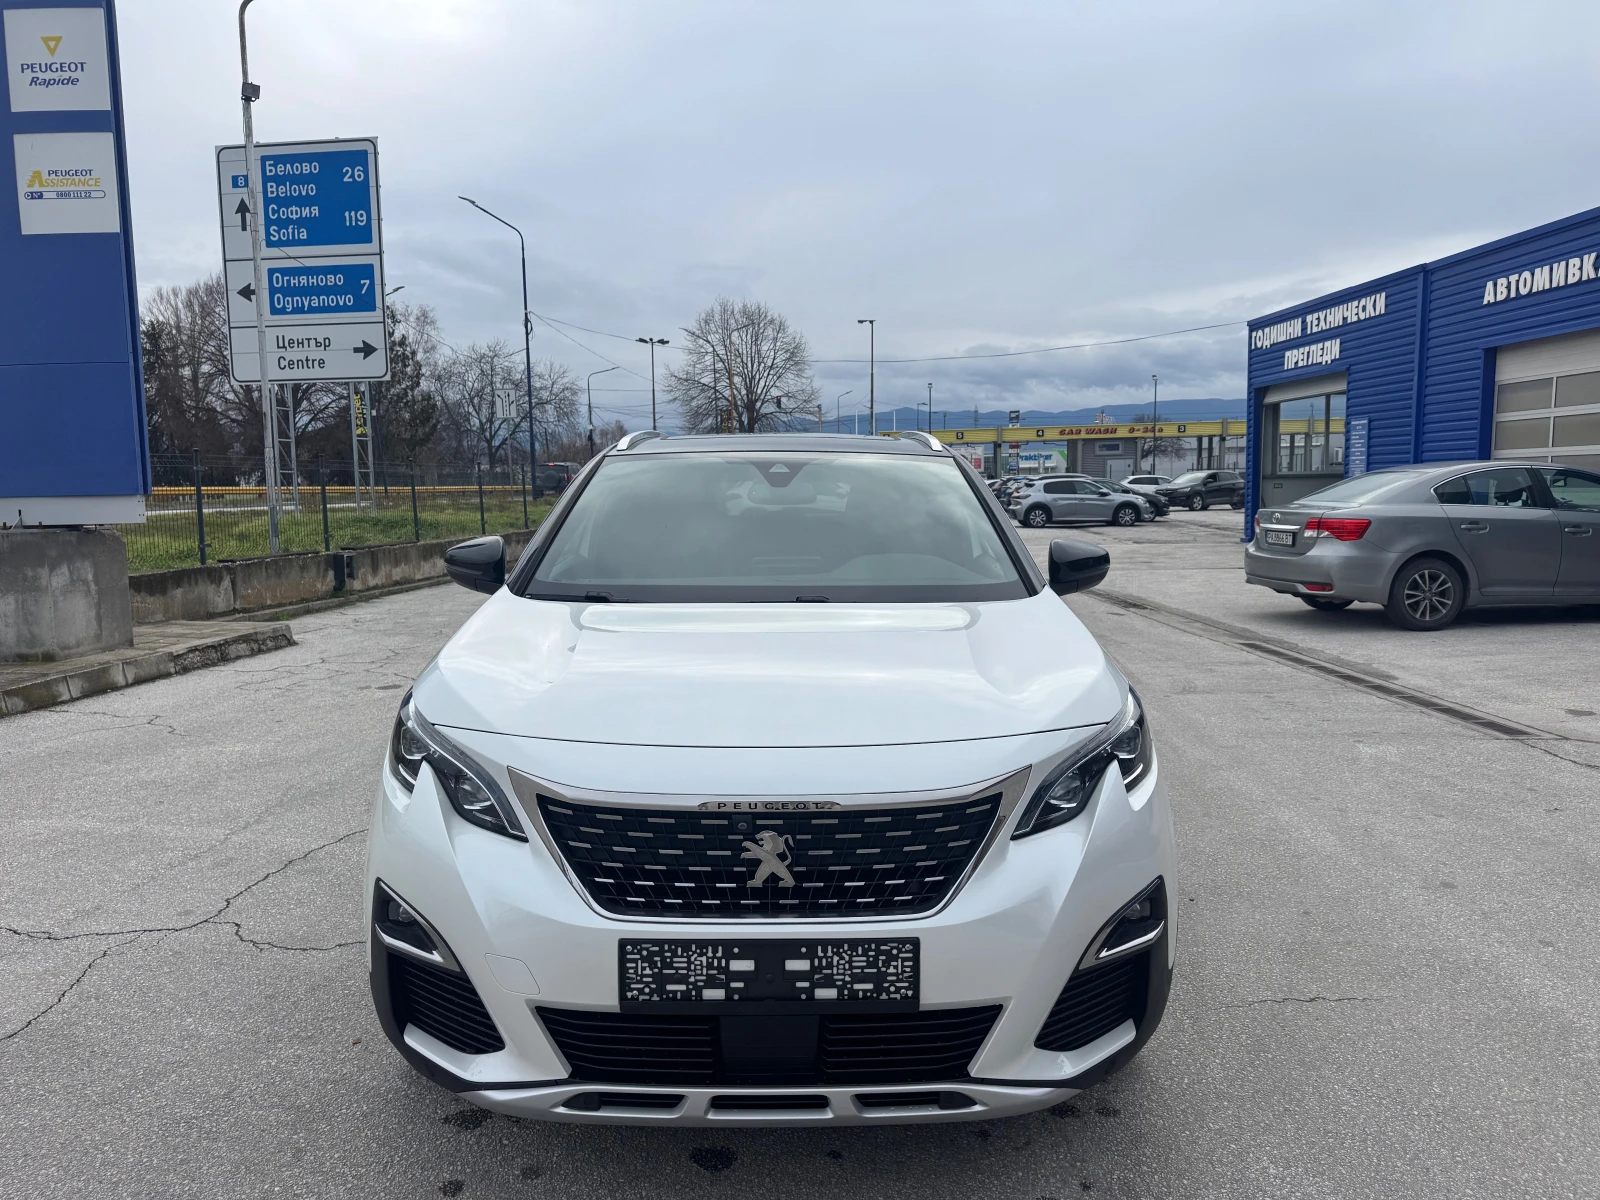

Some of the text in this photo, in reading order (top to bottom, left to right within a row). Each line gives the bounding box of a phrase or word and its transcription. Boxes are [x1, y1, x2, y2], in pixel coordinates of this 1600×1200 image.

[20, 62, 87, 74] PEUGEOT
[28, 75, 80, 88] Rapide
[26, 170, 102, 189] ASSISTANCE
[47, 169, 94, 177] PEUGEOT
[265, 161, 365, 182] Белово 26
[237, 176, 245, 187] 8
[267, 181, 316, 198] Belovo
[268, 204, 367, 227] София 119
[269, 225, 308, 241] Sofia
[272, 273, 371, 295] Огняново 7
[1483, 251, 1600, 305] АВТОМИВК
[274, 293, 354, 312] Ognyanovo
[1251, 292, 1386, 350] ГОДИШНИ ТЕХНИЧЕСКИ
[276, 335, 331, 351] Център
[1284, 338, 1341, 370] ПРЕГЛЕДИ
[277, 355, 326, 371] Centre
[1058, 428, 1082, 436] CAR
[1085, 427, 1117, 435] WASH
[717, 802, 822, 810] PEUGEOT
